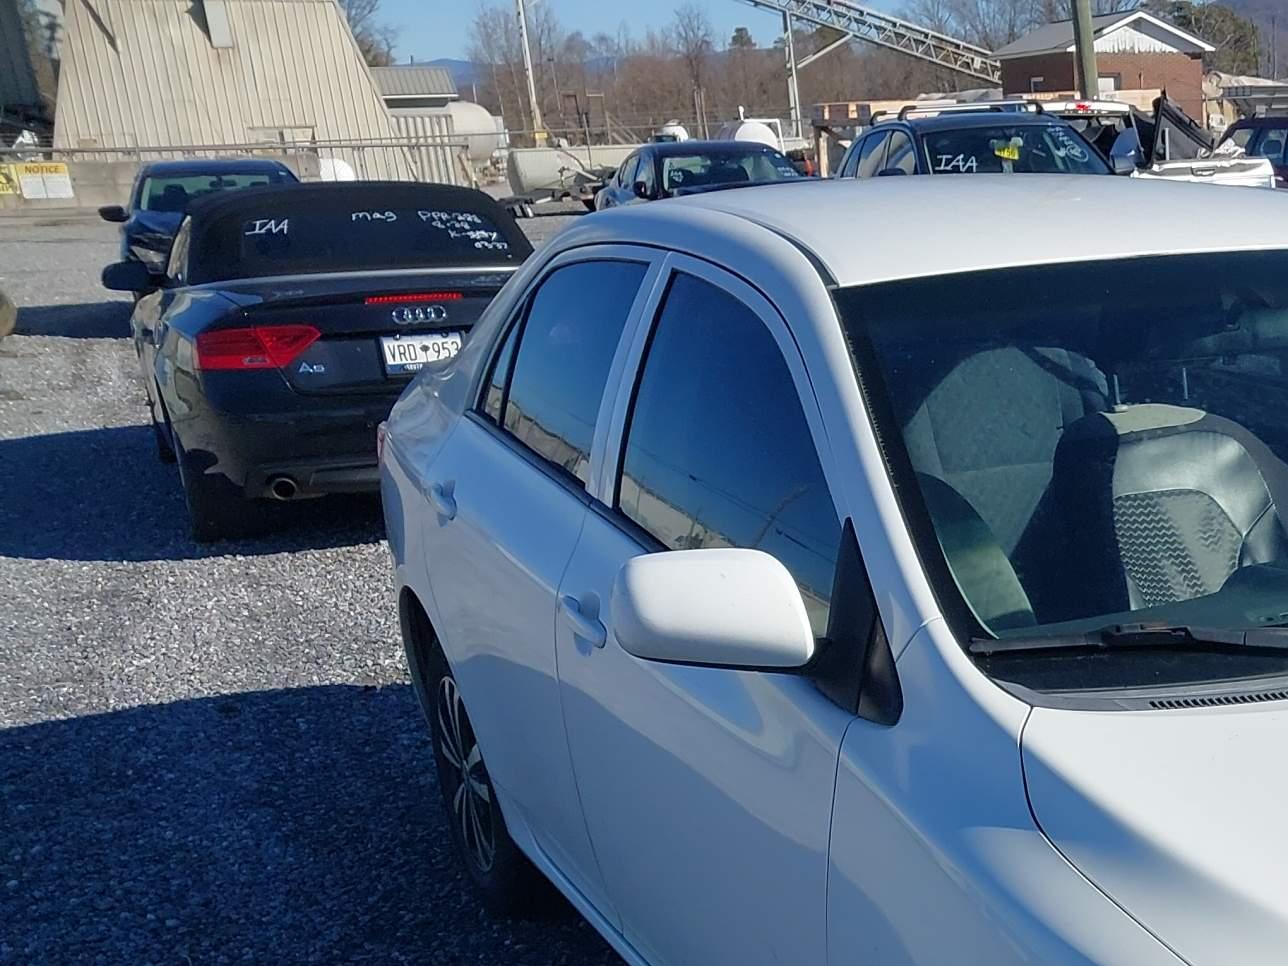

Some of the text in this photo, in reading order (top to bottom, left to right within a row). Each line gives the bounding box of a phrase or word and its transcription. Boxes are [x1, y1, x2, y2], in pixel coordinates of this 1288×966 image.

[935, 154, 977, 172] IAA
[245, 219, 288, 235] IAA
[388, 344, 418, 362] VRD
